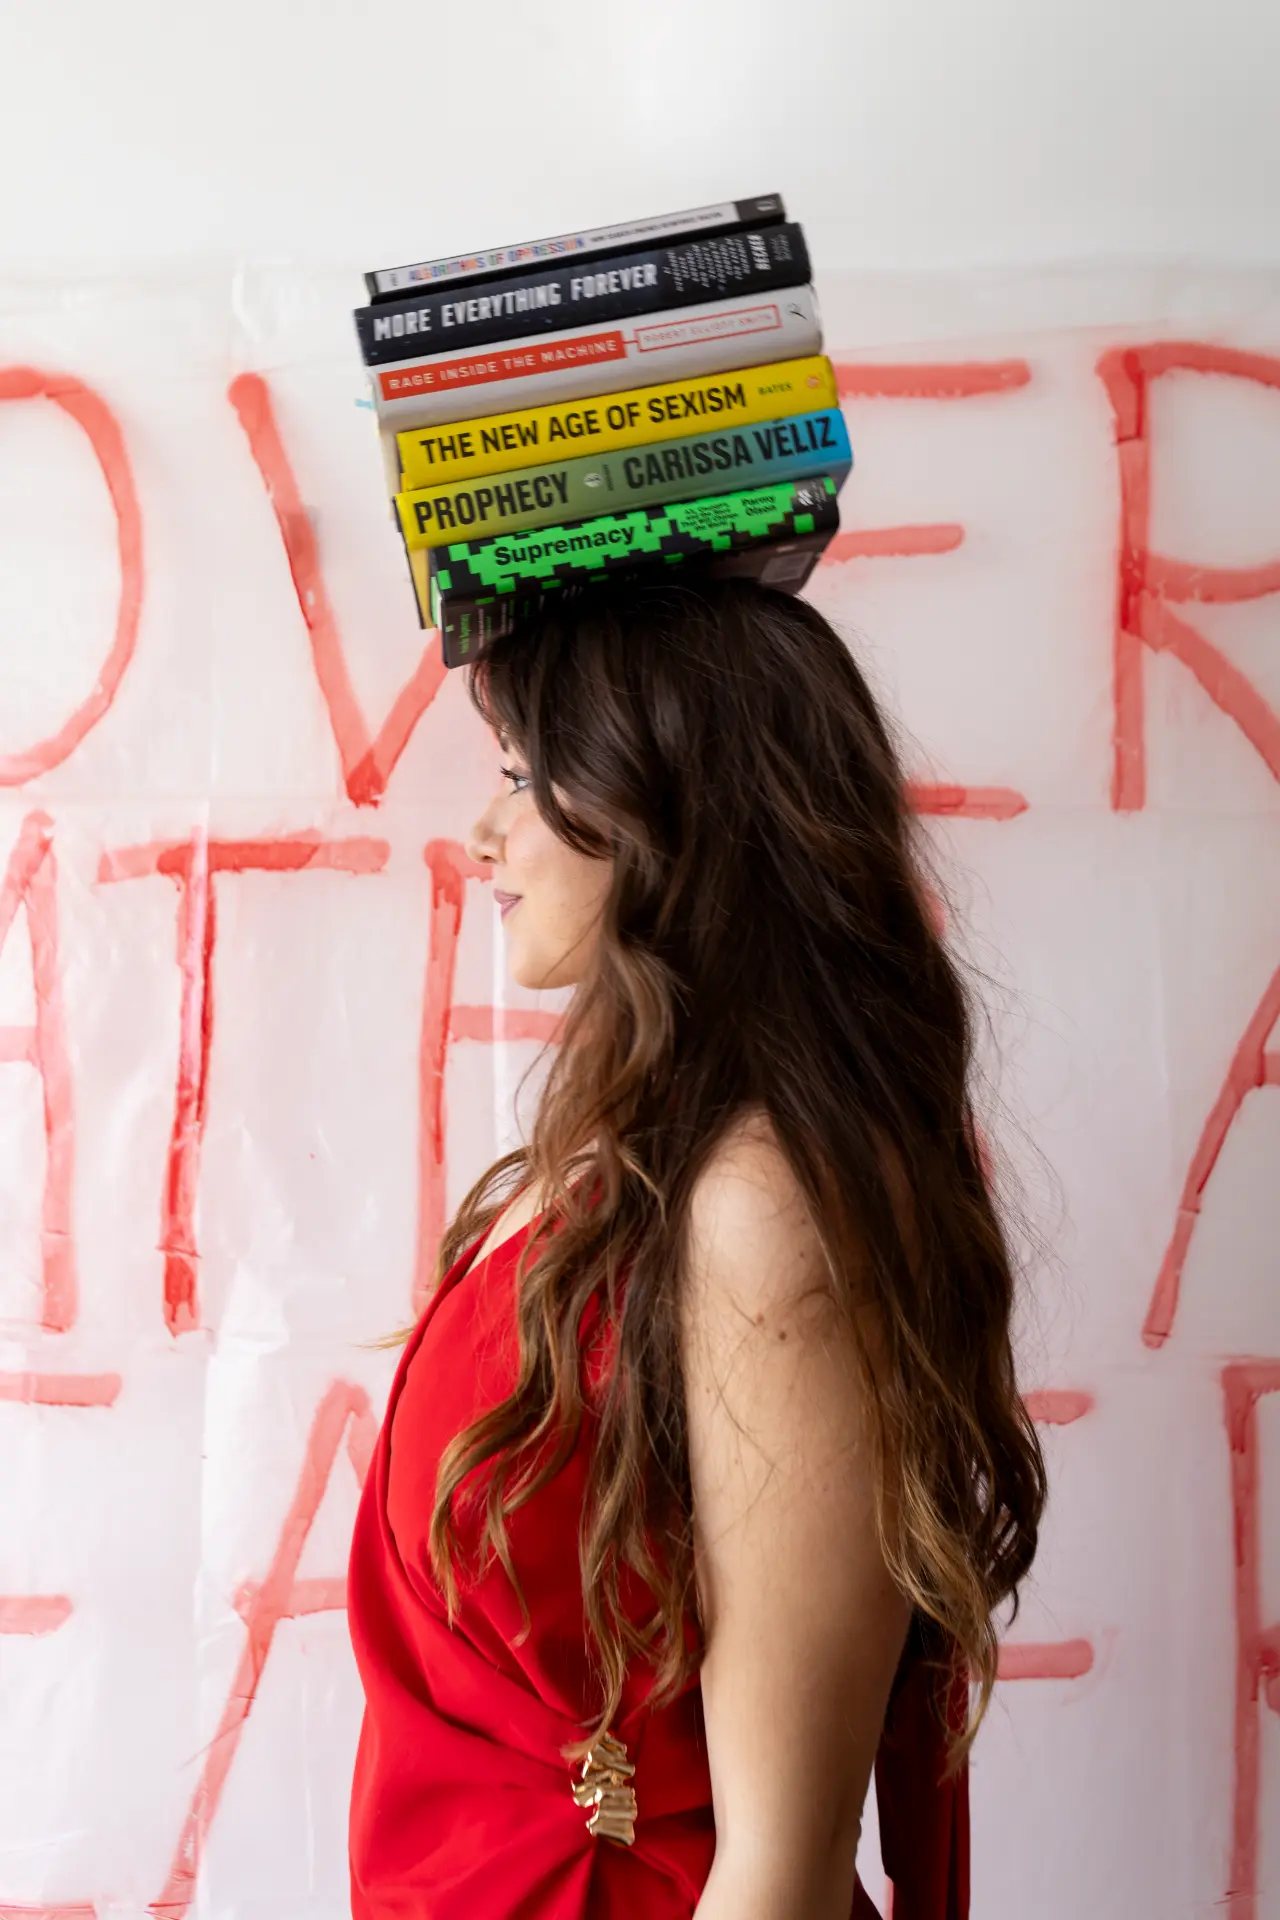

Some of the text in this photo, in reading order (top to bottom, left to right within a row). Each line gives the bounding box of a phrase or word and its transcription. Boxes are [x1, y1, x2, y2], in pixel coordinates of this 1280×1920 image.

[408, 256, 487, 282] ALGORITHMS
[487, 253, 504, 267] OF
[508, 238, 585, 262] OPPRESSION
[374, 264, 658, 341] MORE EVERYTHING FOREVER
[389, 338, 617, 390] RAGE INSIDE THE MACHINE
[419, 383, 747, 464] THE NEW AGE OF SEXISM
[623, 434, 753, 490] CARISSA
[752, 416, 838, 461] VÉLIZ
[413, 471, 568, 534] PROPHECY
[494, 526, 634, 566] Supremacy
